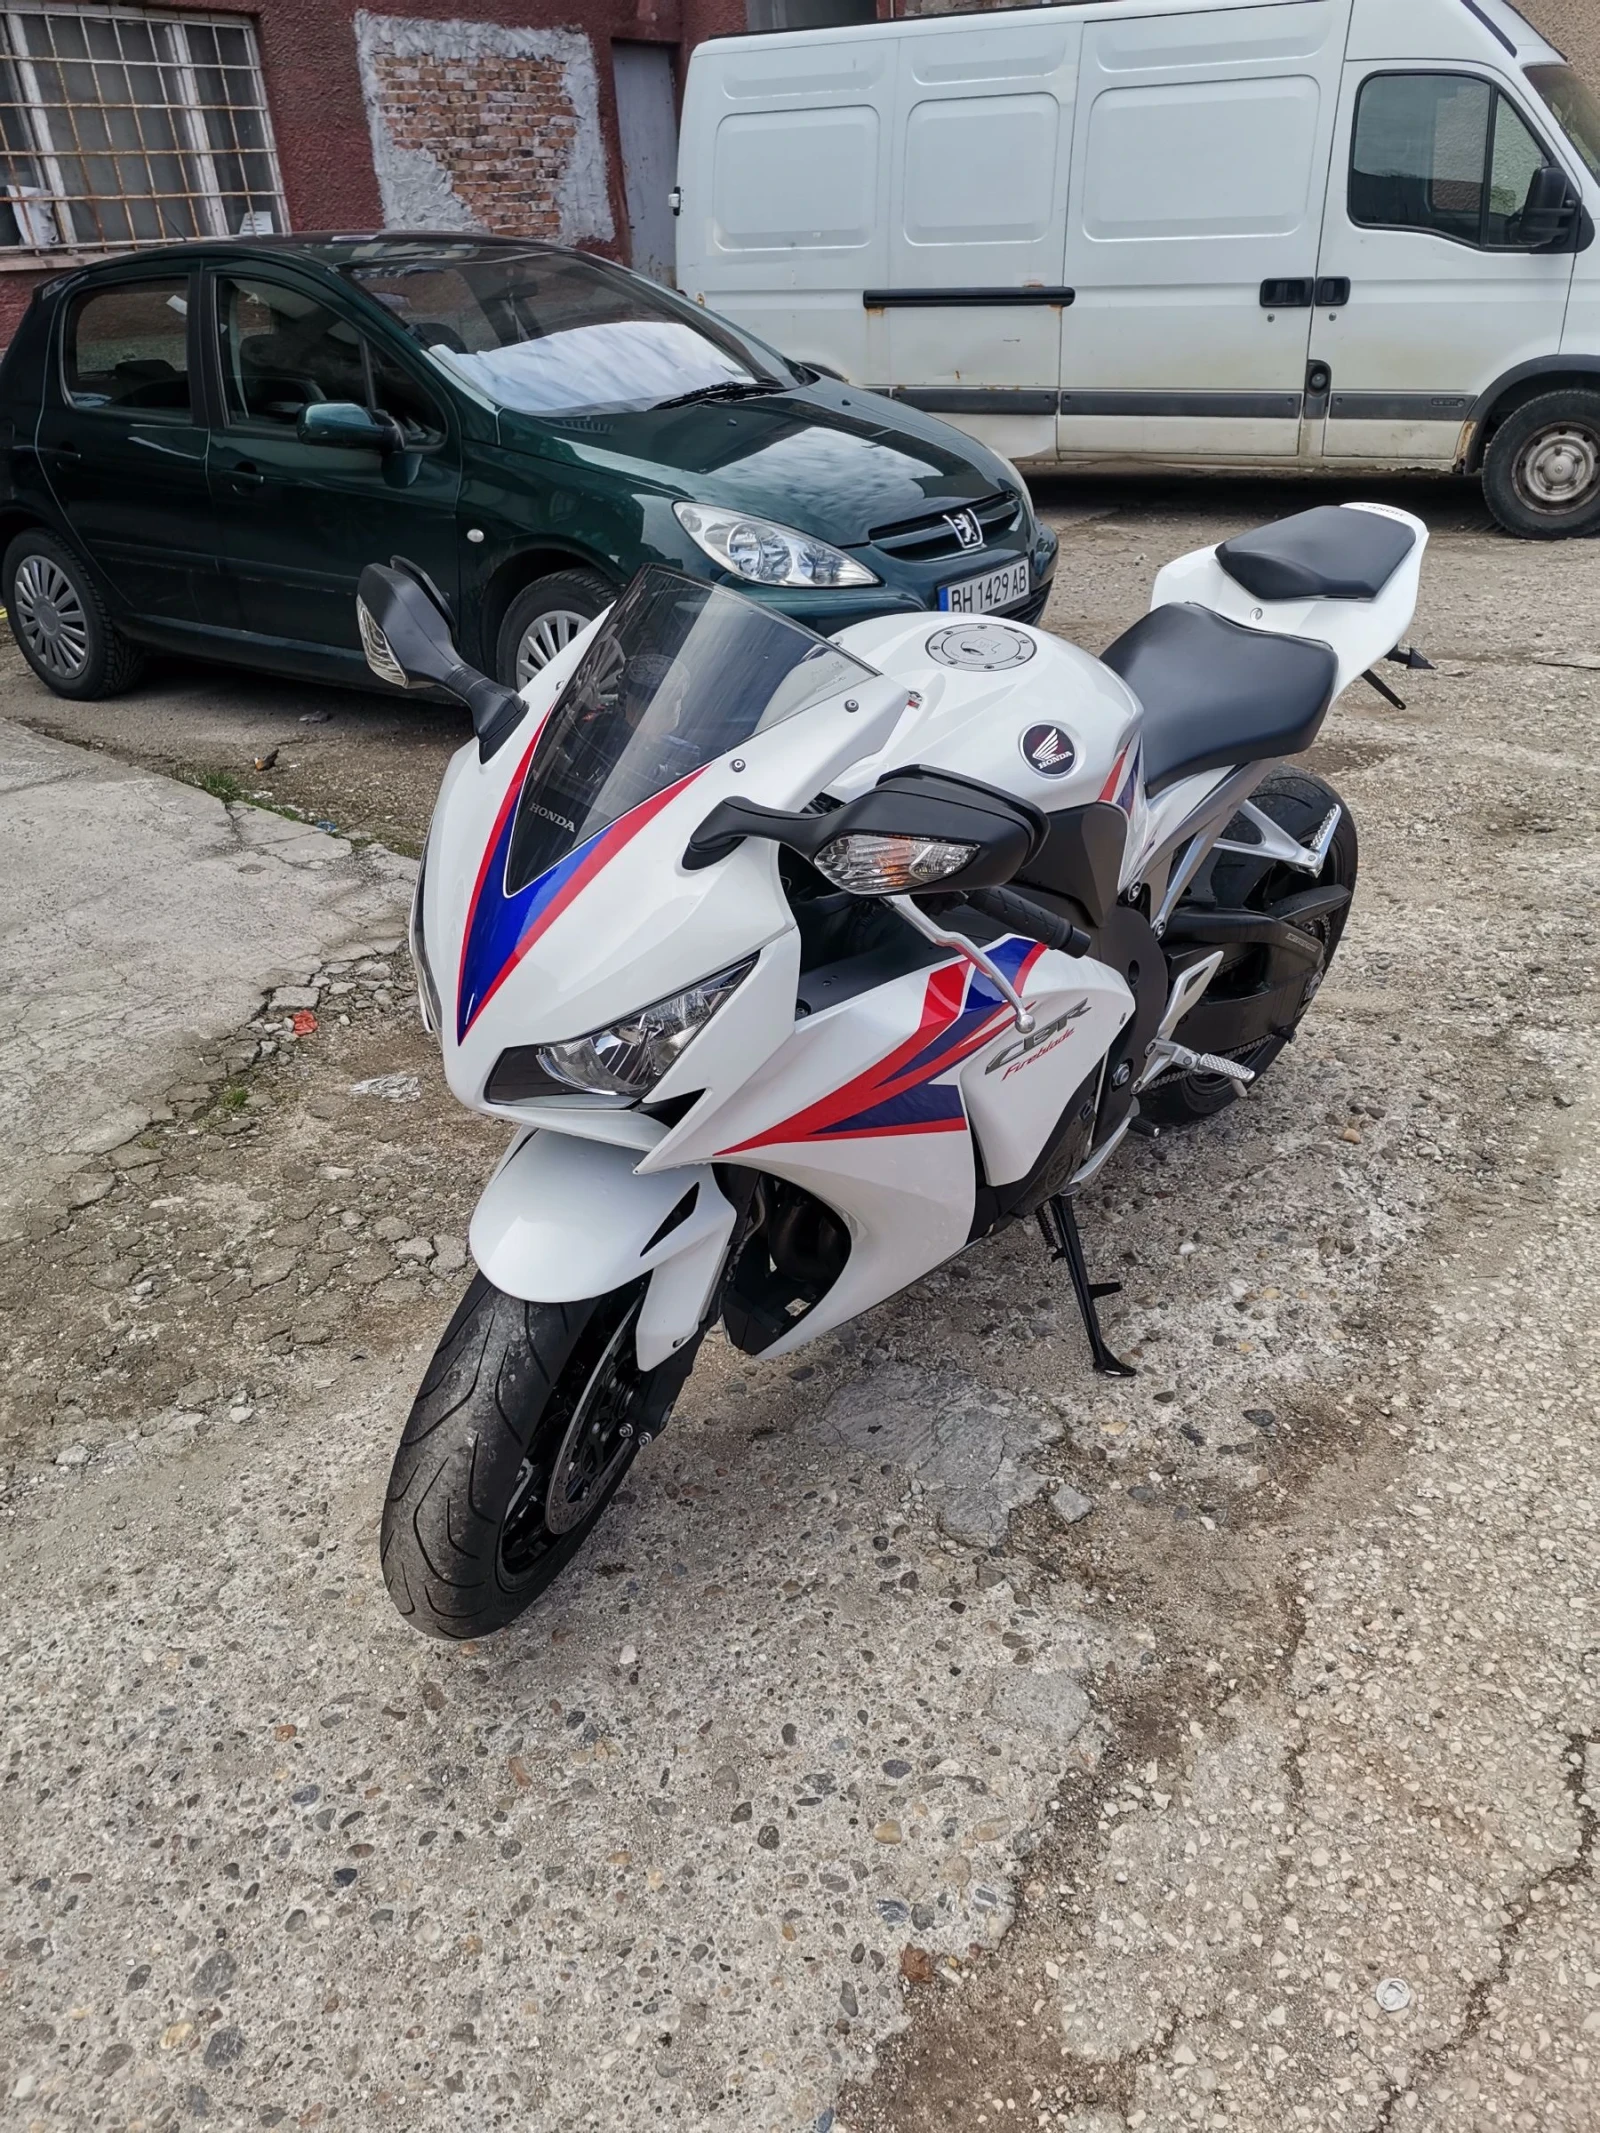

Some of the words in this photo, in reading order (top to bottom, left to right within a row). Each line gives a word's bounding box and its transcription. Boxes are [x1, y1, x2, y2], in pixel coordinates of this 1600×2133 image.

[951, 584, 973, 613] BH
[977, 572, 1009, 609] 1429
[1011, 565, 1027, 597] AB
[1038, 751, 1073, 769] HONDA
[529, 802, 576, 833] HONDA
[984, 997, 1093, 1075] CBR
[1001, 1027, 1075, 1081] Fireblade
